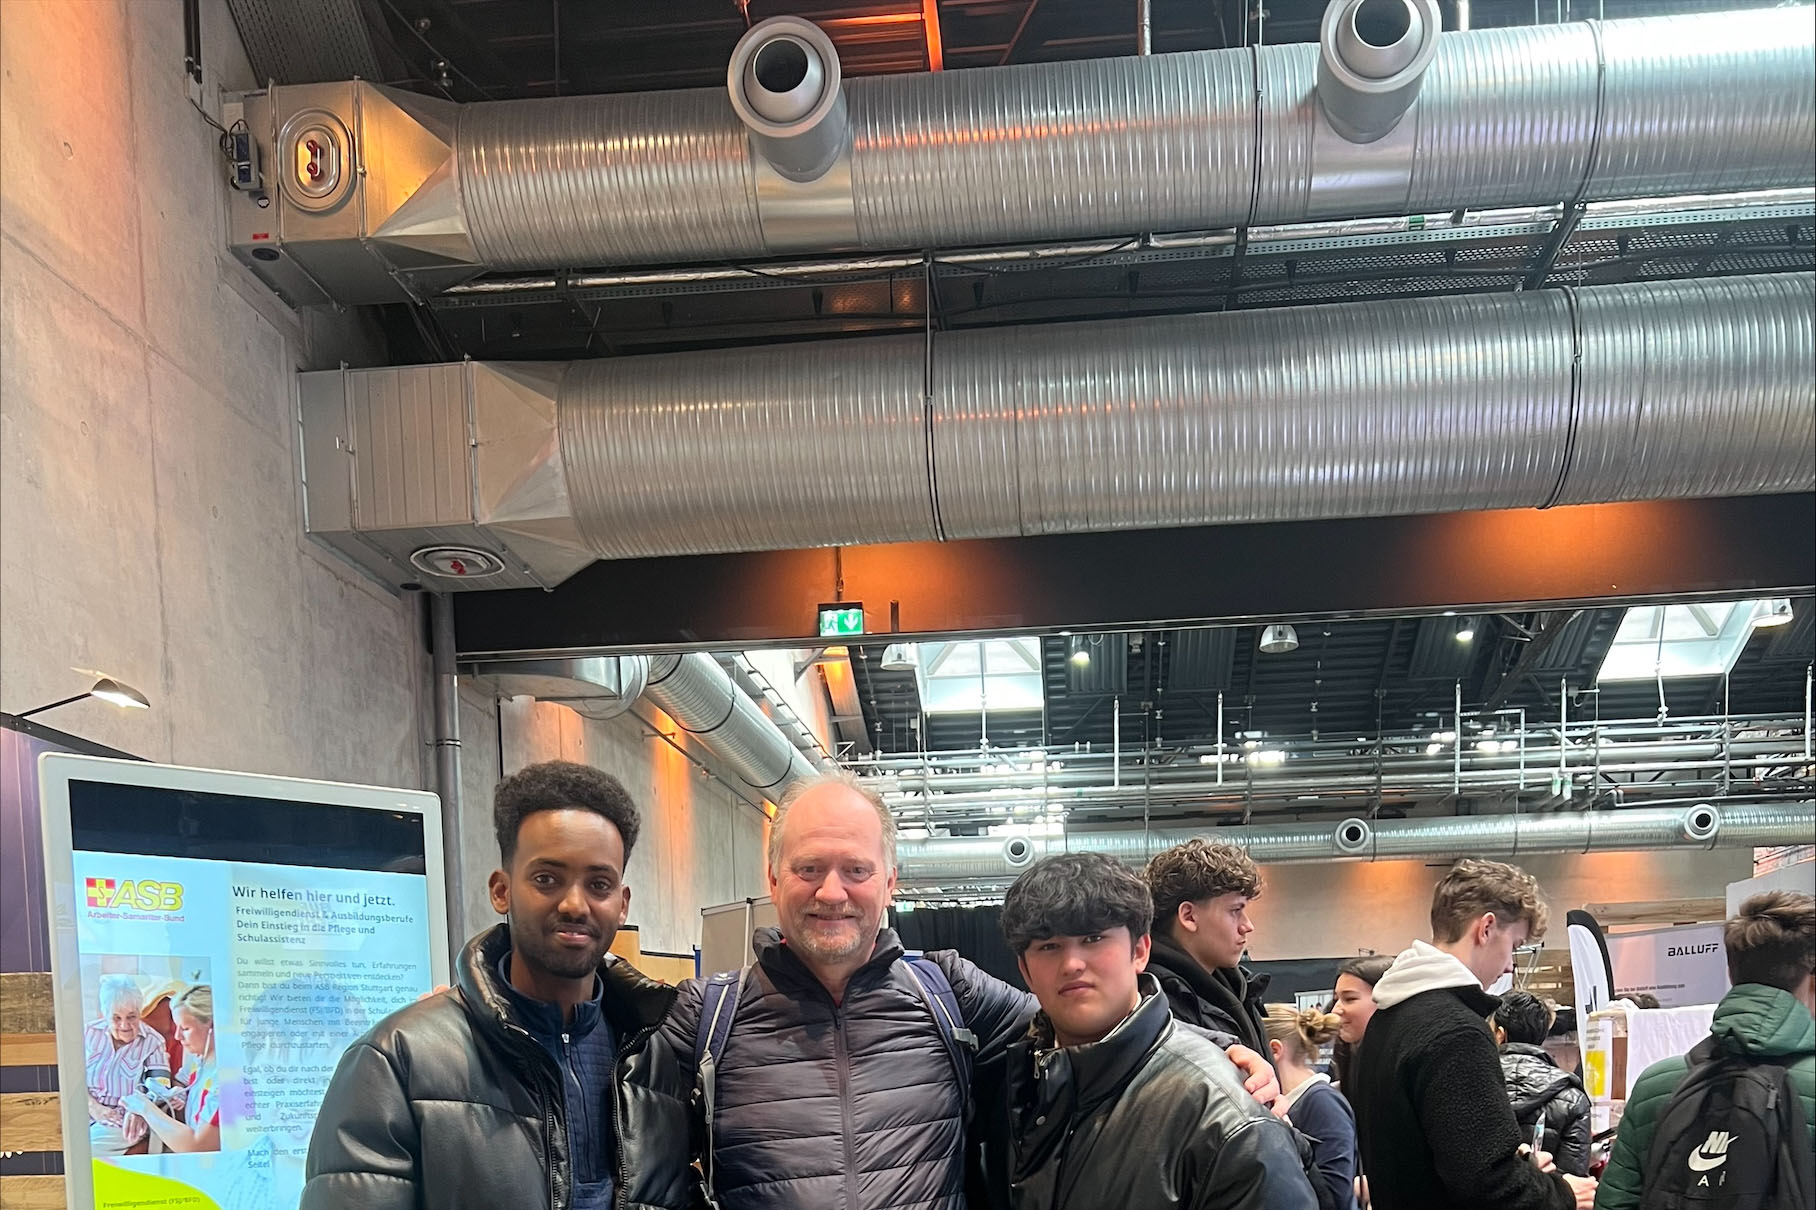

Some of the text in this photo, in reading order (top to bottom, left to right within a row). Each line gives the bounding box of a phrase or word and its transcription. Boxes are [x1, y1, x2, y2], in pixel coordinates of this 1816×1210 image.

[109, 879, 184, 911] ASB
[232, 886, 396, 907] Wir helfen hier und jetzt.
[236, 906, 320, 919] Freiwilligendienst
[331, 911, 414, 924] Ausbildungsberufe
[237, 920, 376, 935] Dein Einstieg in die Pflege und
[237, 933, 306, 944] Schulassistenz
[1667, 943, 1719, 957] BALLUFF
[237, 957, 248, 965] Du
[372, 962, 417, 971] Erfahrungen
[275, 970, 291, 978] und
